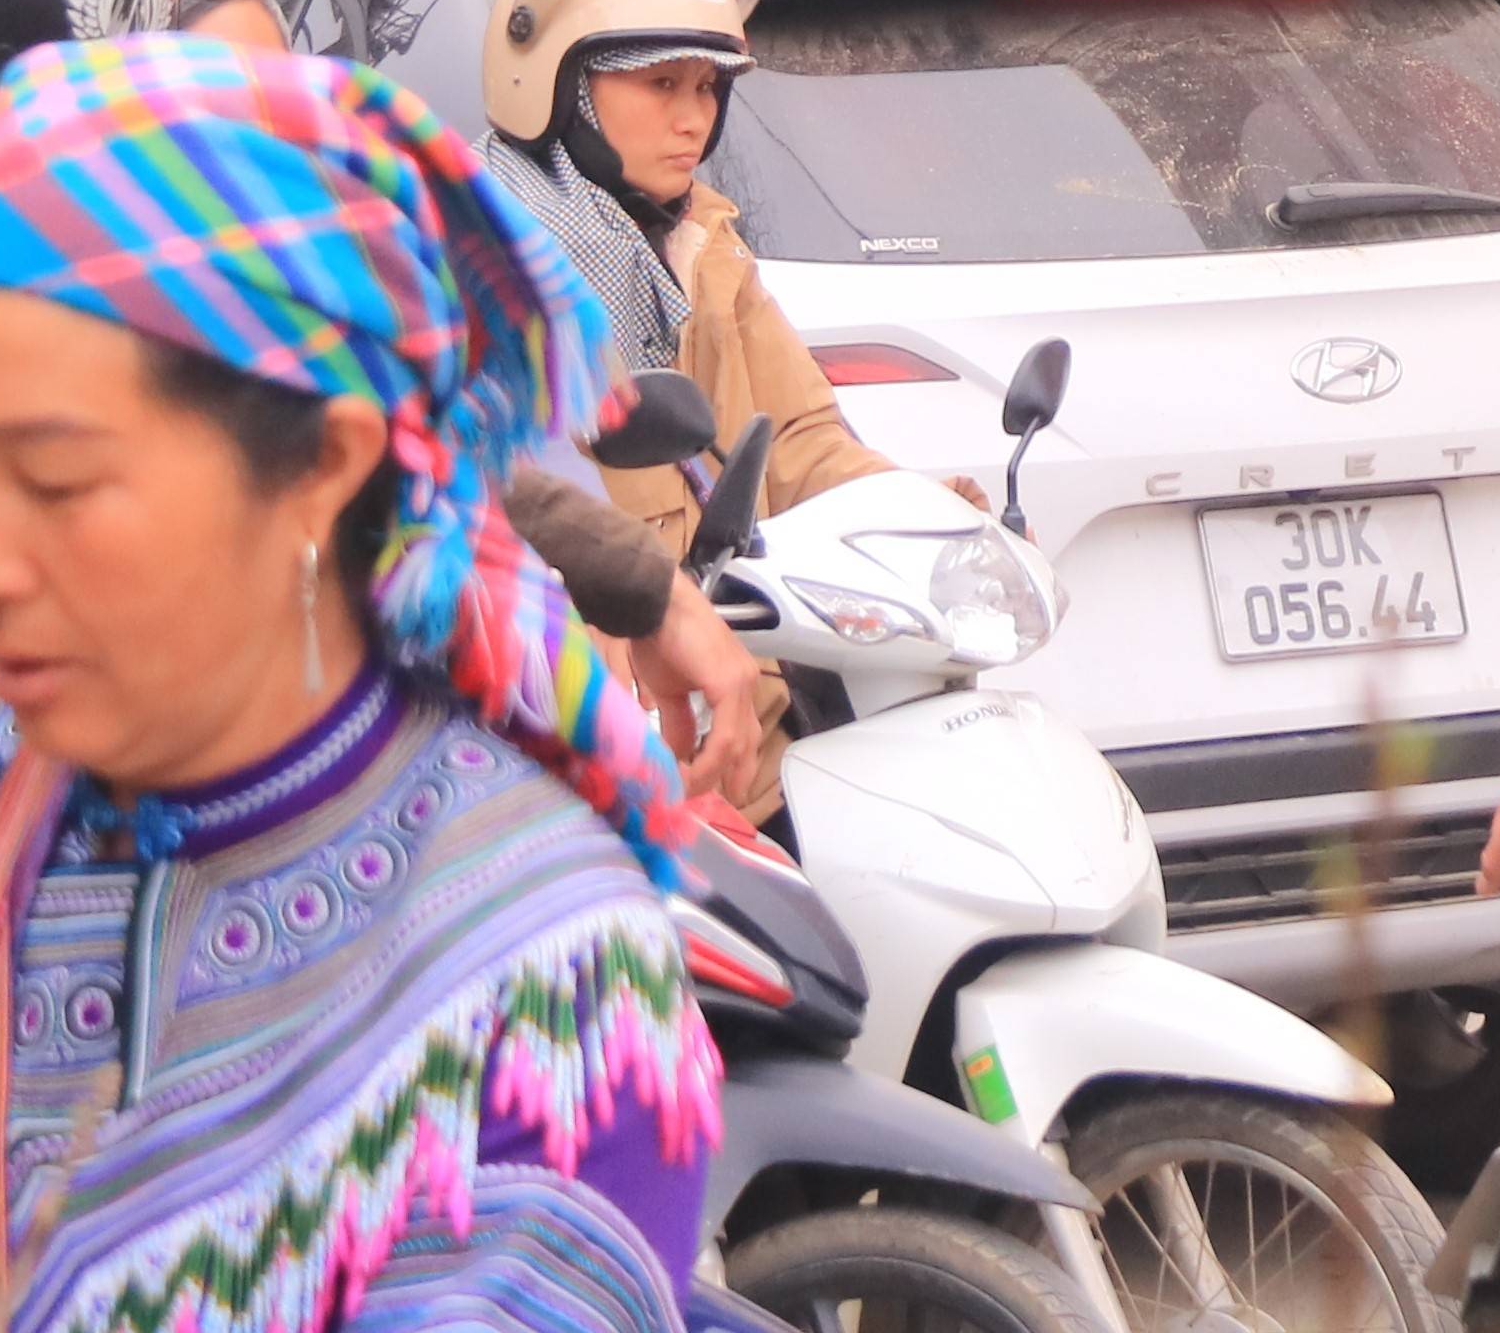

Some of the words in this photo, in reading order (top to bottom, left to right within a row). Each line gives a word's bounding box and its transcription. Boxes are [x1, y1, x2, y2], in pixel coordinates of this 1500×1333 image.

[859, 236, 941, 253] NEXCO
[1275, 505, 1382, 571] 30K
[1243, 570, 1437, 646] 056.44
